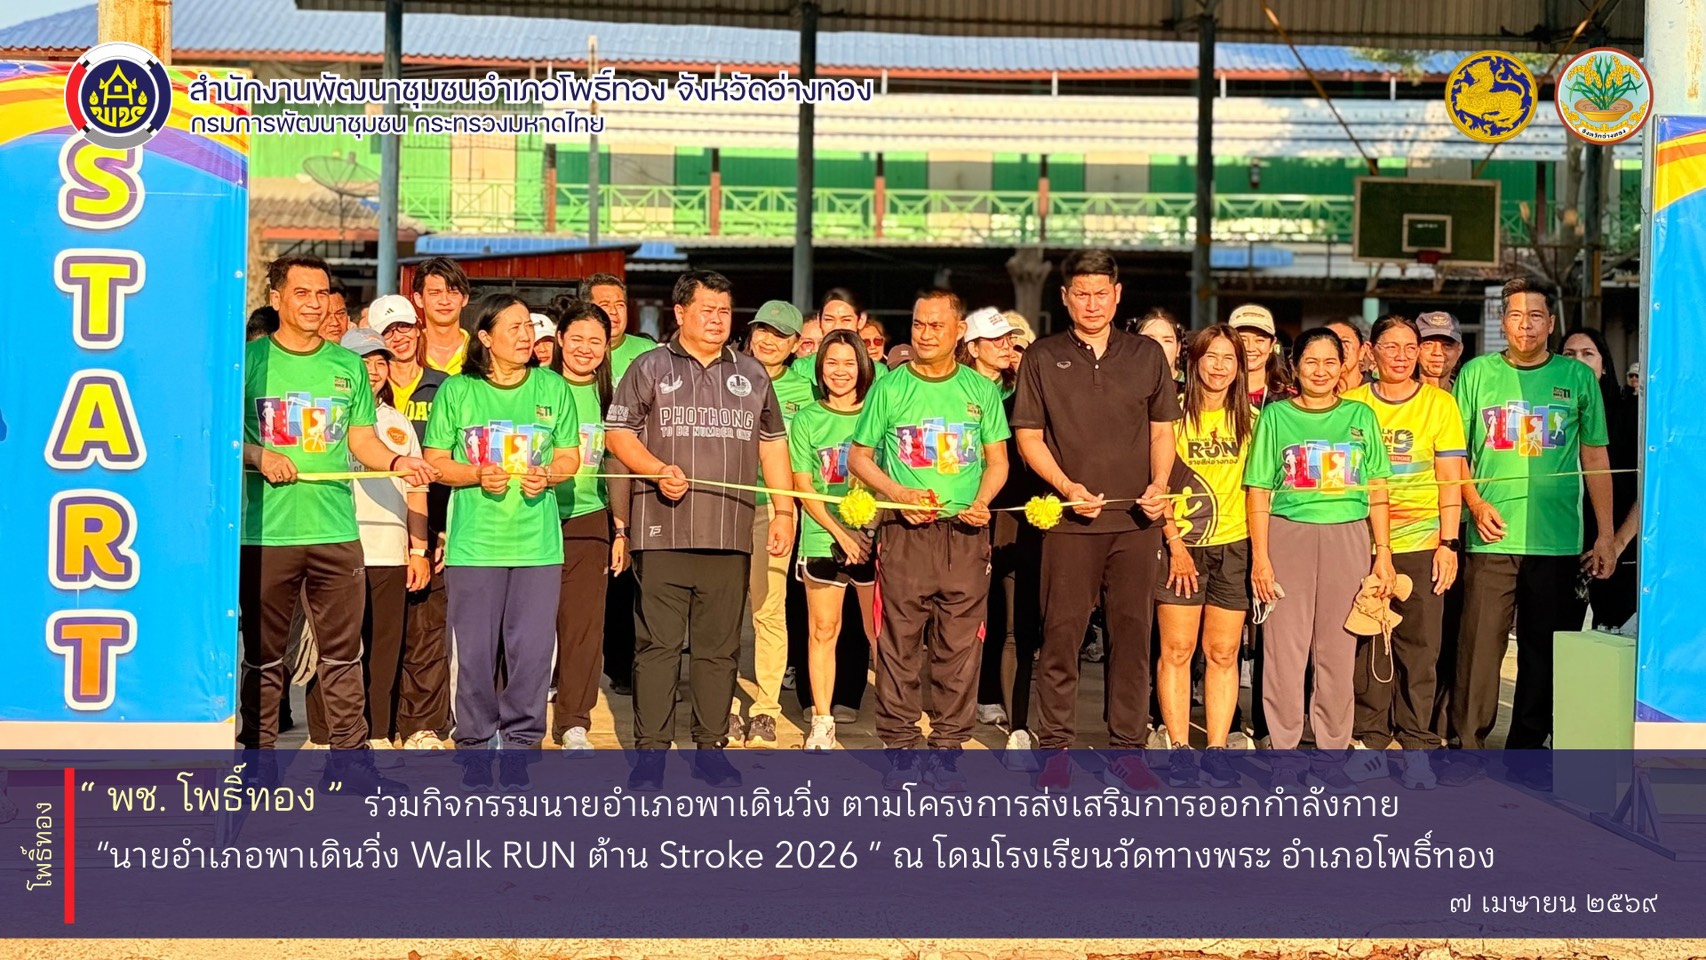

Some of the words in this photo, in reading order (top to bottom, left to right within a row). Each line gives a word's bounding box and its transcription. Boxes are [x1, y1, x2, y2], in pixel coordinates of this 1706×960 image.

[44, 130, 147, 711] START
[659, 406, 754, 429] PHOTHONG
[661, 427, 673, 437] TO
[676, 426, 690, 437] BE
[693, 426, 734, 438] NUMBER
[737, 429, 752, 441] ONE
[1187, 441, 1240, 459] RUN
